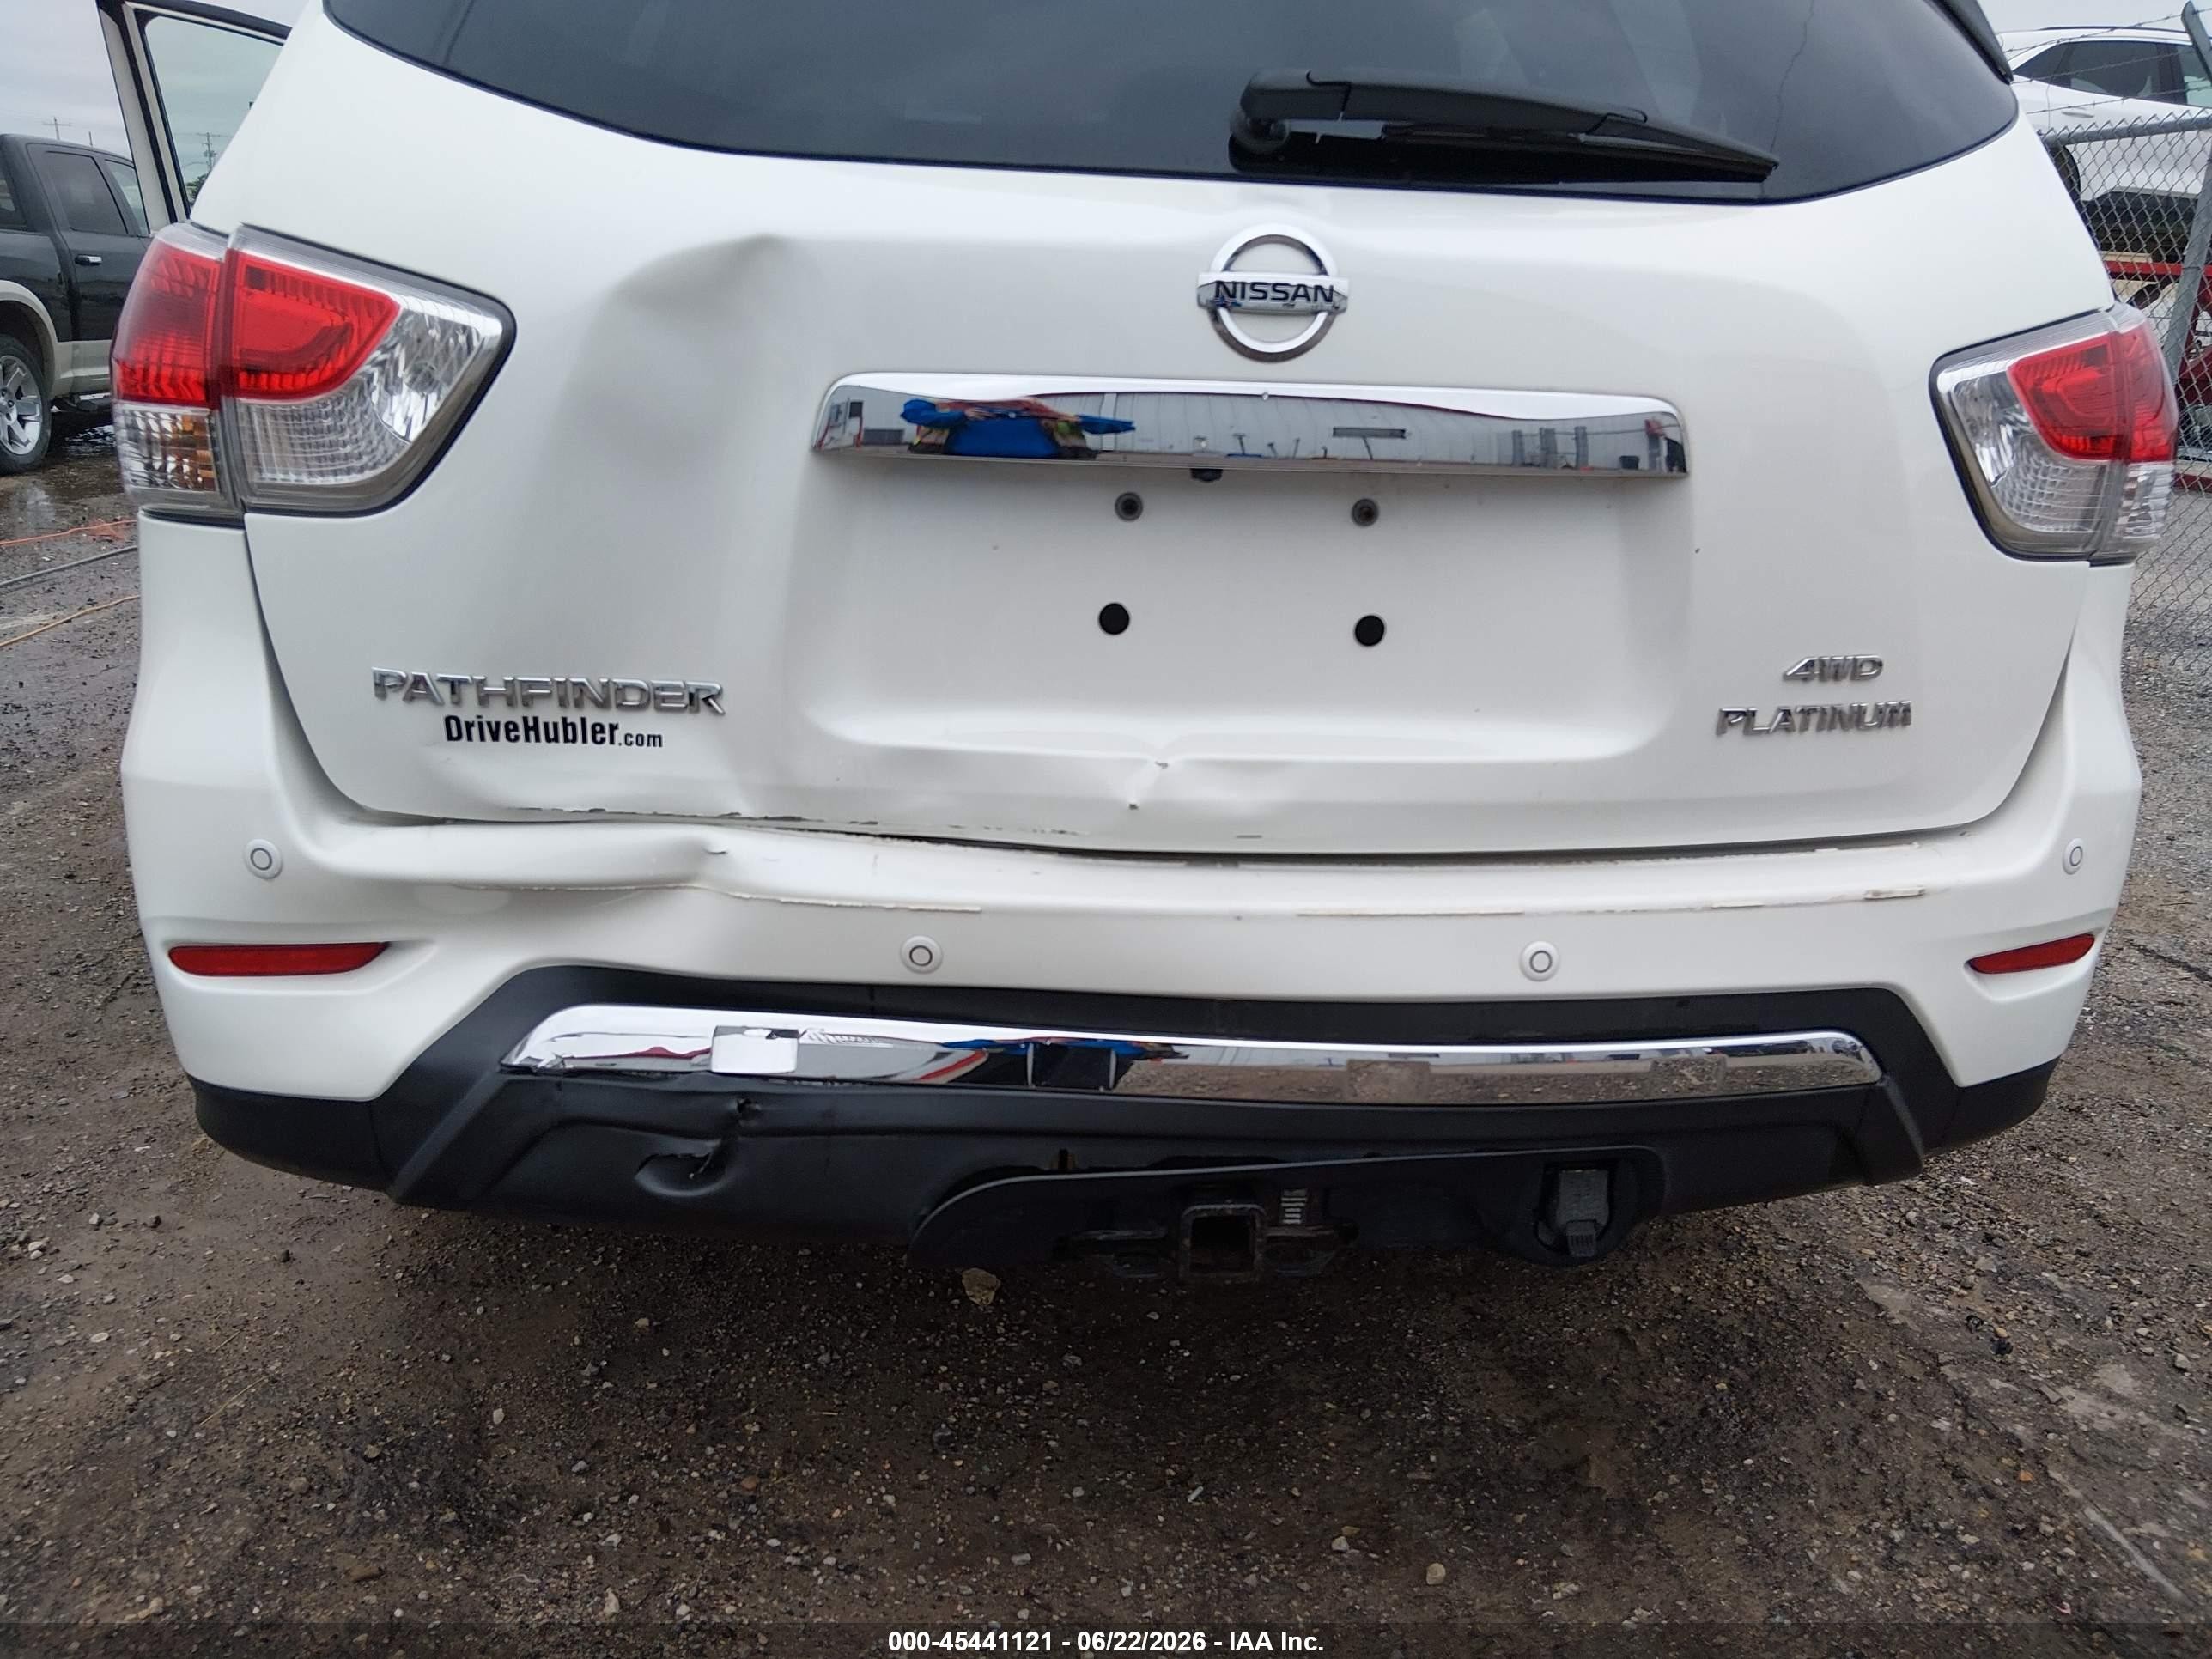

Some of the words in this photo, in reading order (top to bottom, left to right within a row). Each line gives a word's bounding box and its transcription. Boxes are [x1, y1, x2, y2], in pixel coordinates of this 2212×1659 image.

[1213, 279, 1334, 303] NISSAN
[1783, 654, 1884, 683] 4WD
[371, 666, 726, 715] PATHFINDER
[444, 714, 664, 748] DriveHubler.com
[1716, 700, 1912, 736] PLATINUM
